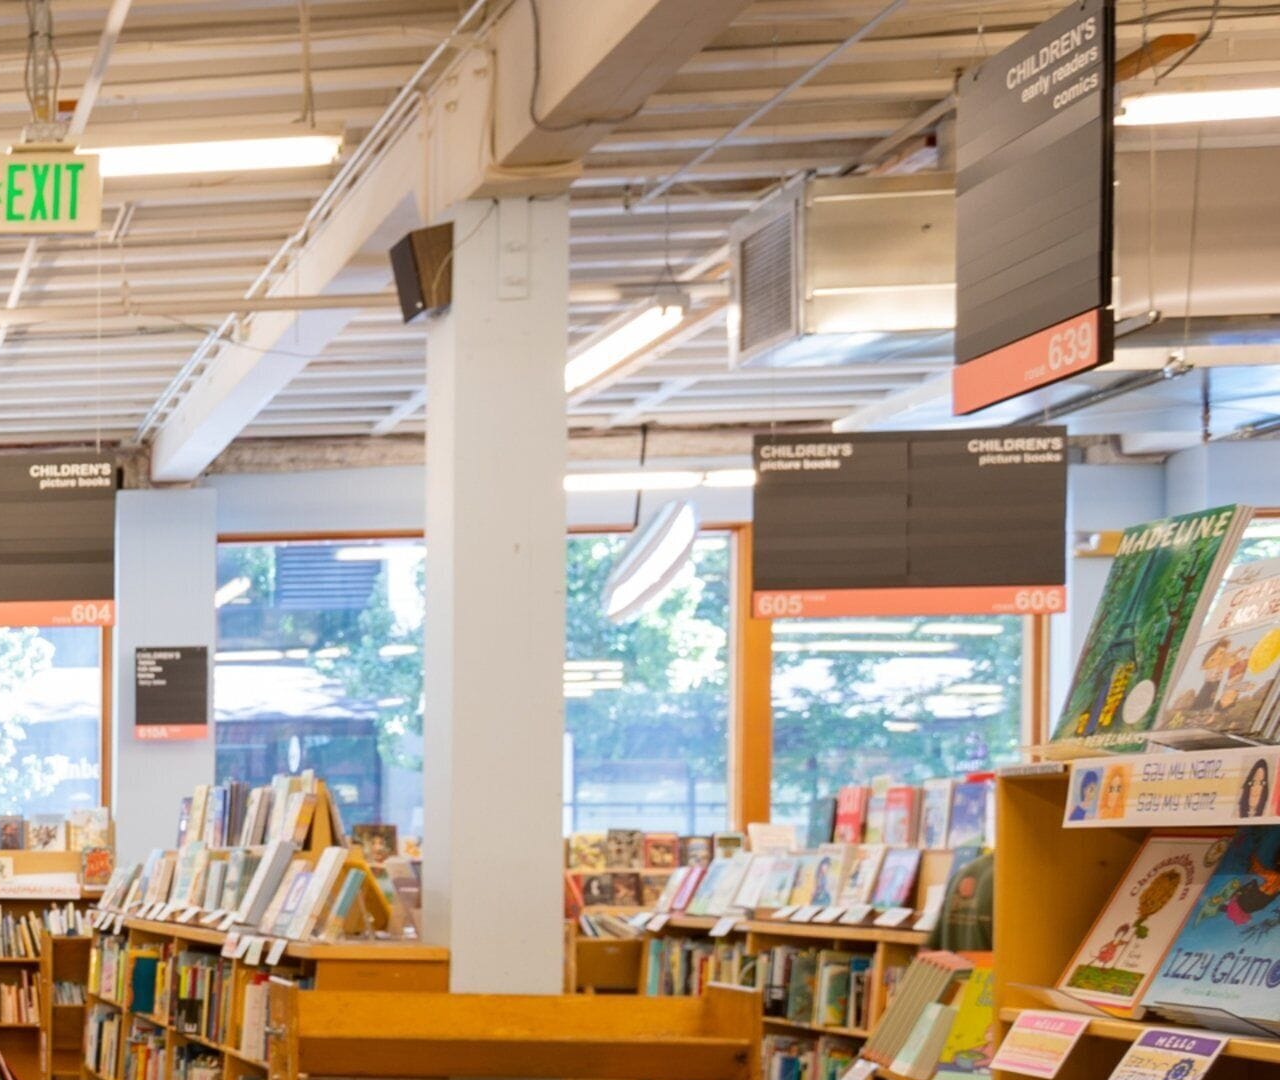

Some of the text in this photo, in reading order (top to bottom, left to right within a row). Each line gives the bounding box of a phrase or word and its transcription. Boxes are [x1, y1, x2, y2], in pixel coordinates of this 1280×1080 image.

[1005, 16, 1097, 91] CHILDREN'S
[1021, 44, 1098, 103] early readers
[1052, 71, 1099, 110] comics
[5, 162, 85, 222] EXIT
[1047, 321, 1093, 372] 639
[759, 443, 854, 460] CHILDREN'S
[967, 436, 1064, 453] CHILDREN'S
[759, 457, 841, 472] picture books
[978, 451, 1063, 467] picture books
[28, 463, 112, 478] CHILDREN'S
[39, 476, 111, 490] picture books
[1114, 510, 1233, 558] MADELINE
[757, 593, 804, 616] 605
[1014, 589, 1063, 611] 606
[70, 603, 112, 623] 604
[1153, 1034, 1197, 1051] HELLO
